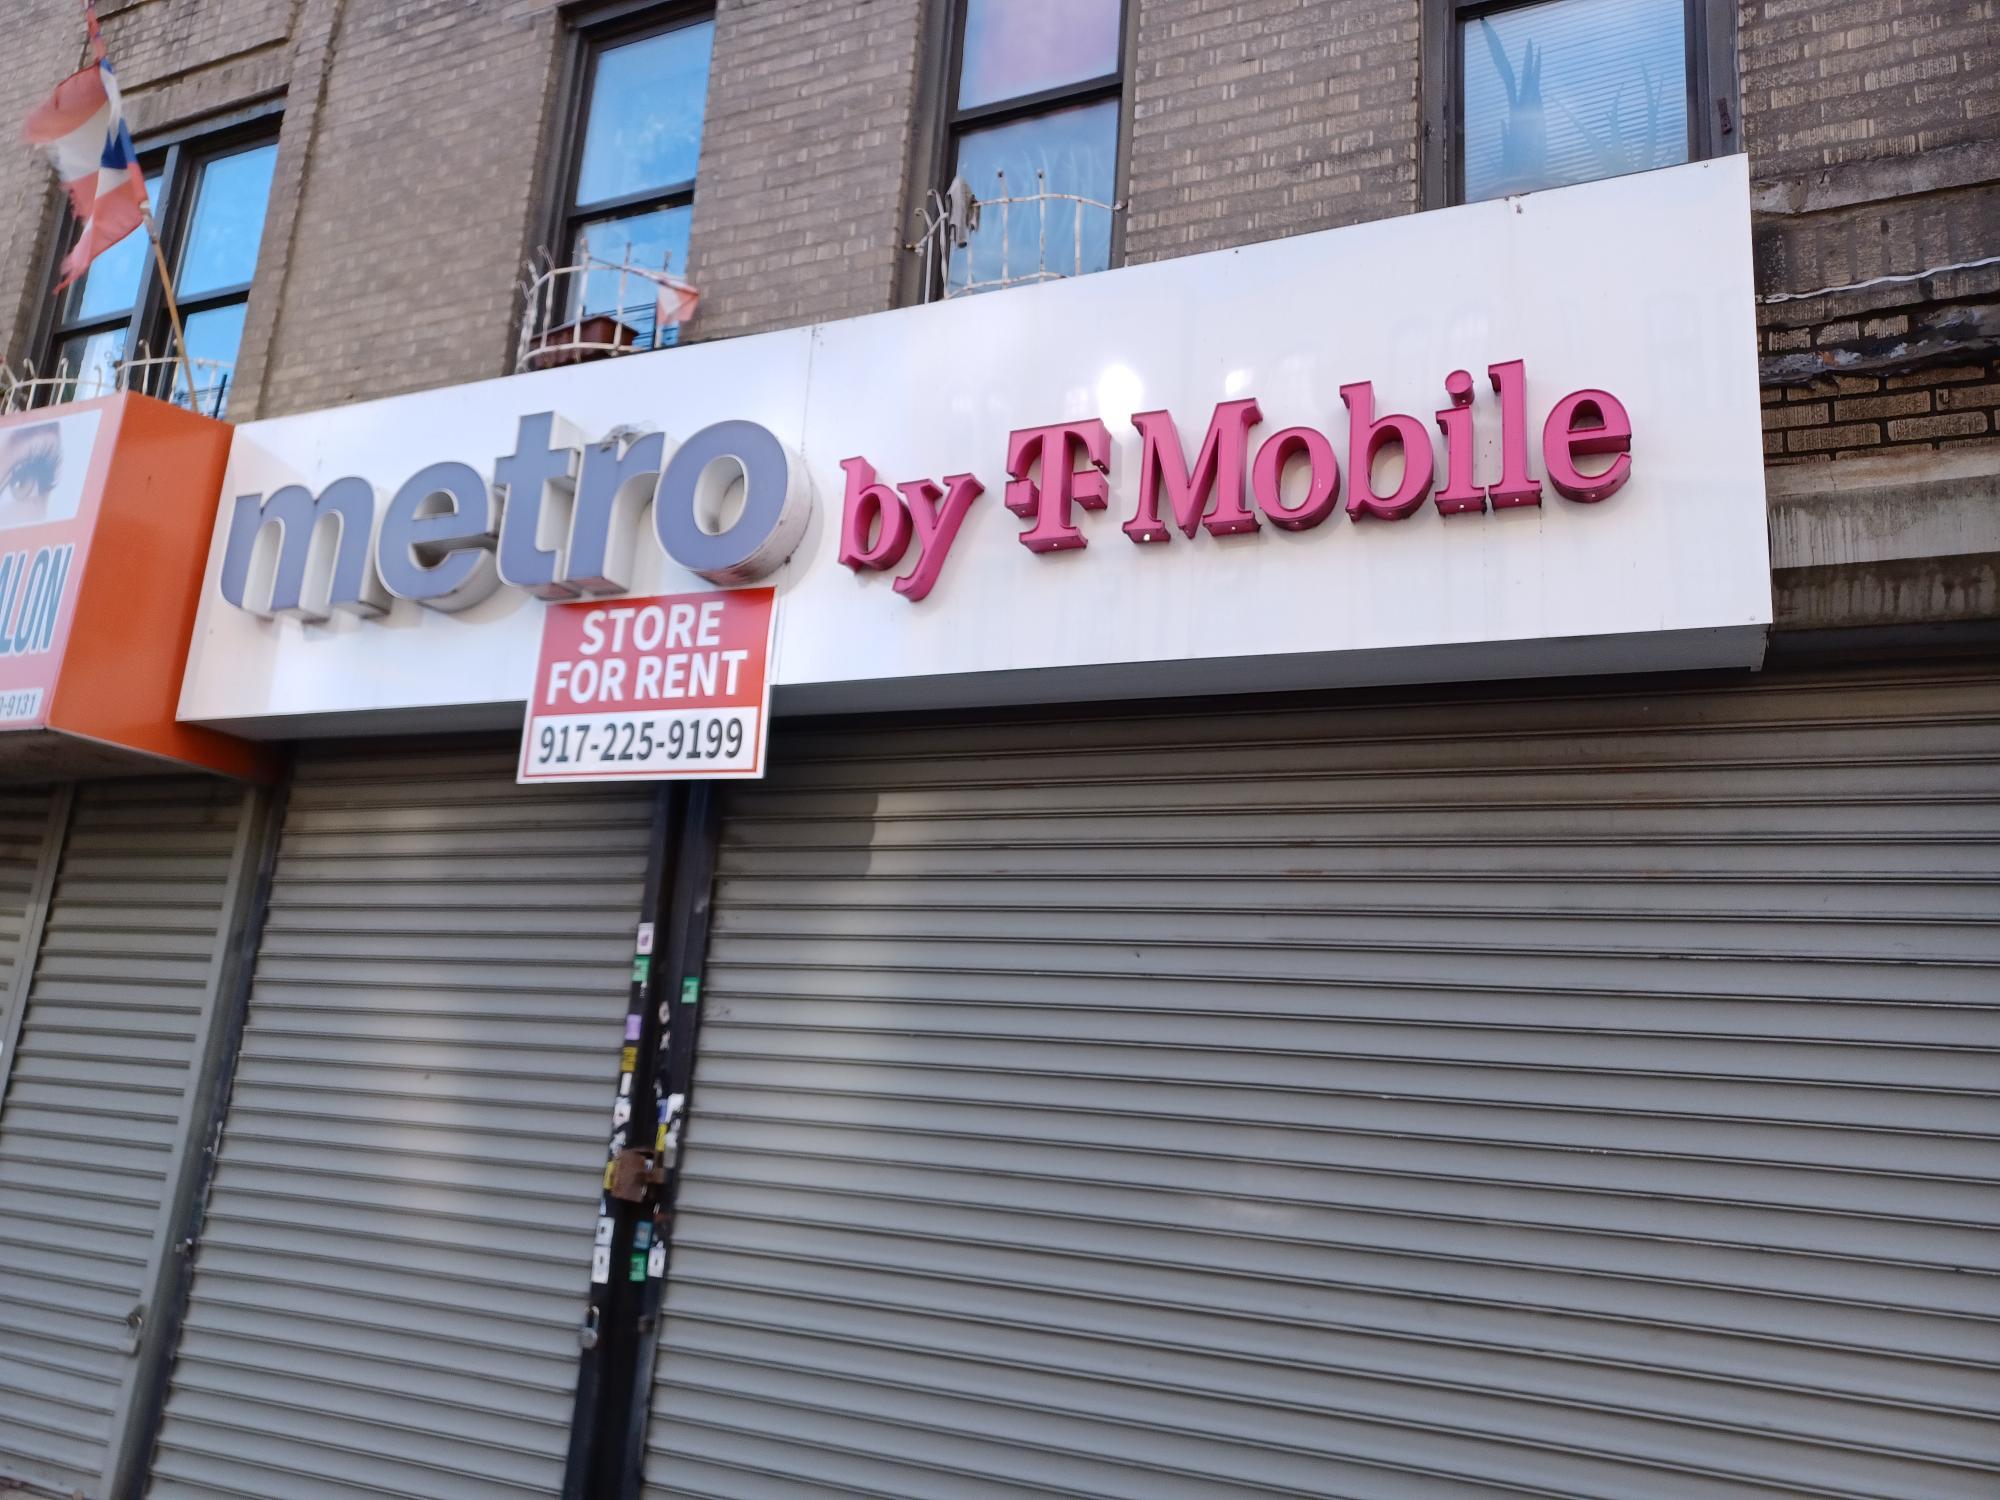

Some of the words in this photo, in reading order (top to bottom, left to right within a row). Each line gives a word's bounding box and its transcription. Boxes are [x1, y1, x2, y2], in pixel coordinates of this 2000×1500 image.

[218, 411, 806, 612] metro
[839, 455, 985, 601] by
[578, 601, 725, 656] STORE
[546, 657, 627, 705] FOR
[634, 649, 748, 700] RENT
[538, 717, 744, 764] 917-225-9199
